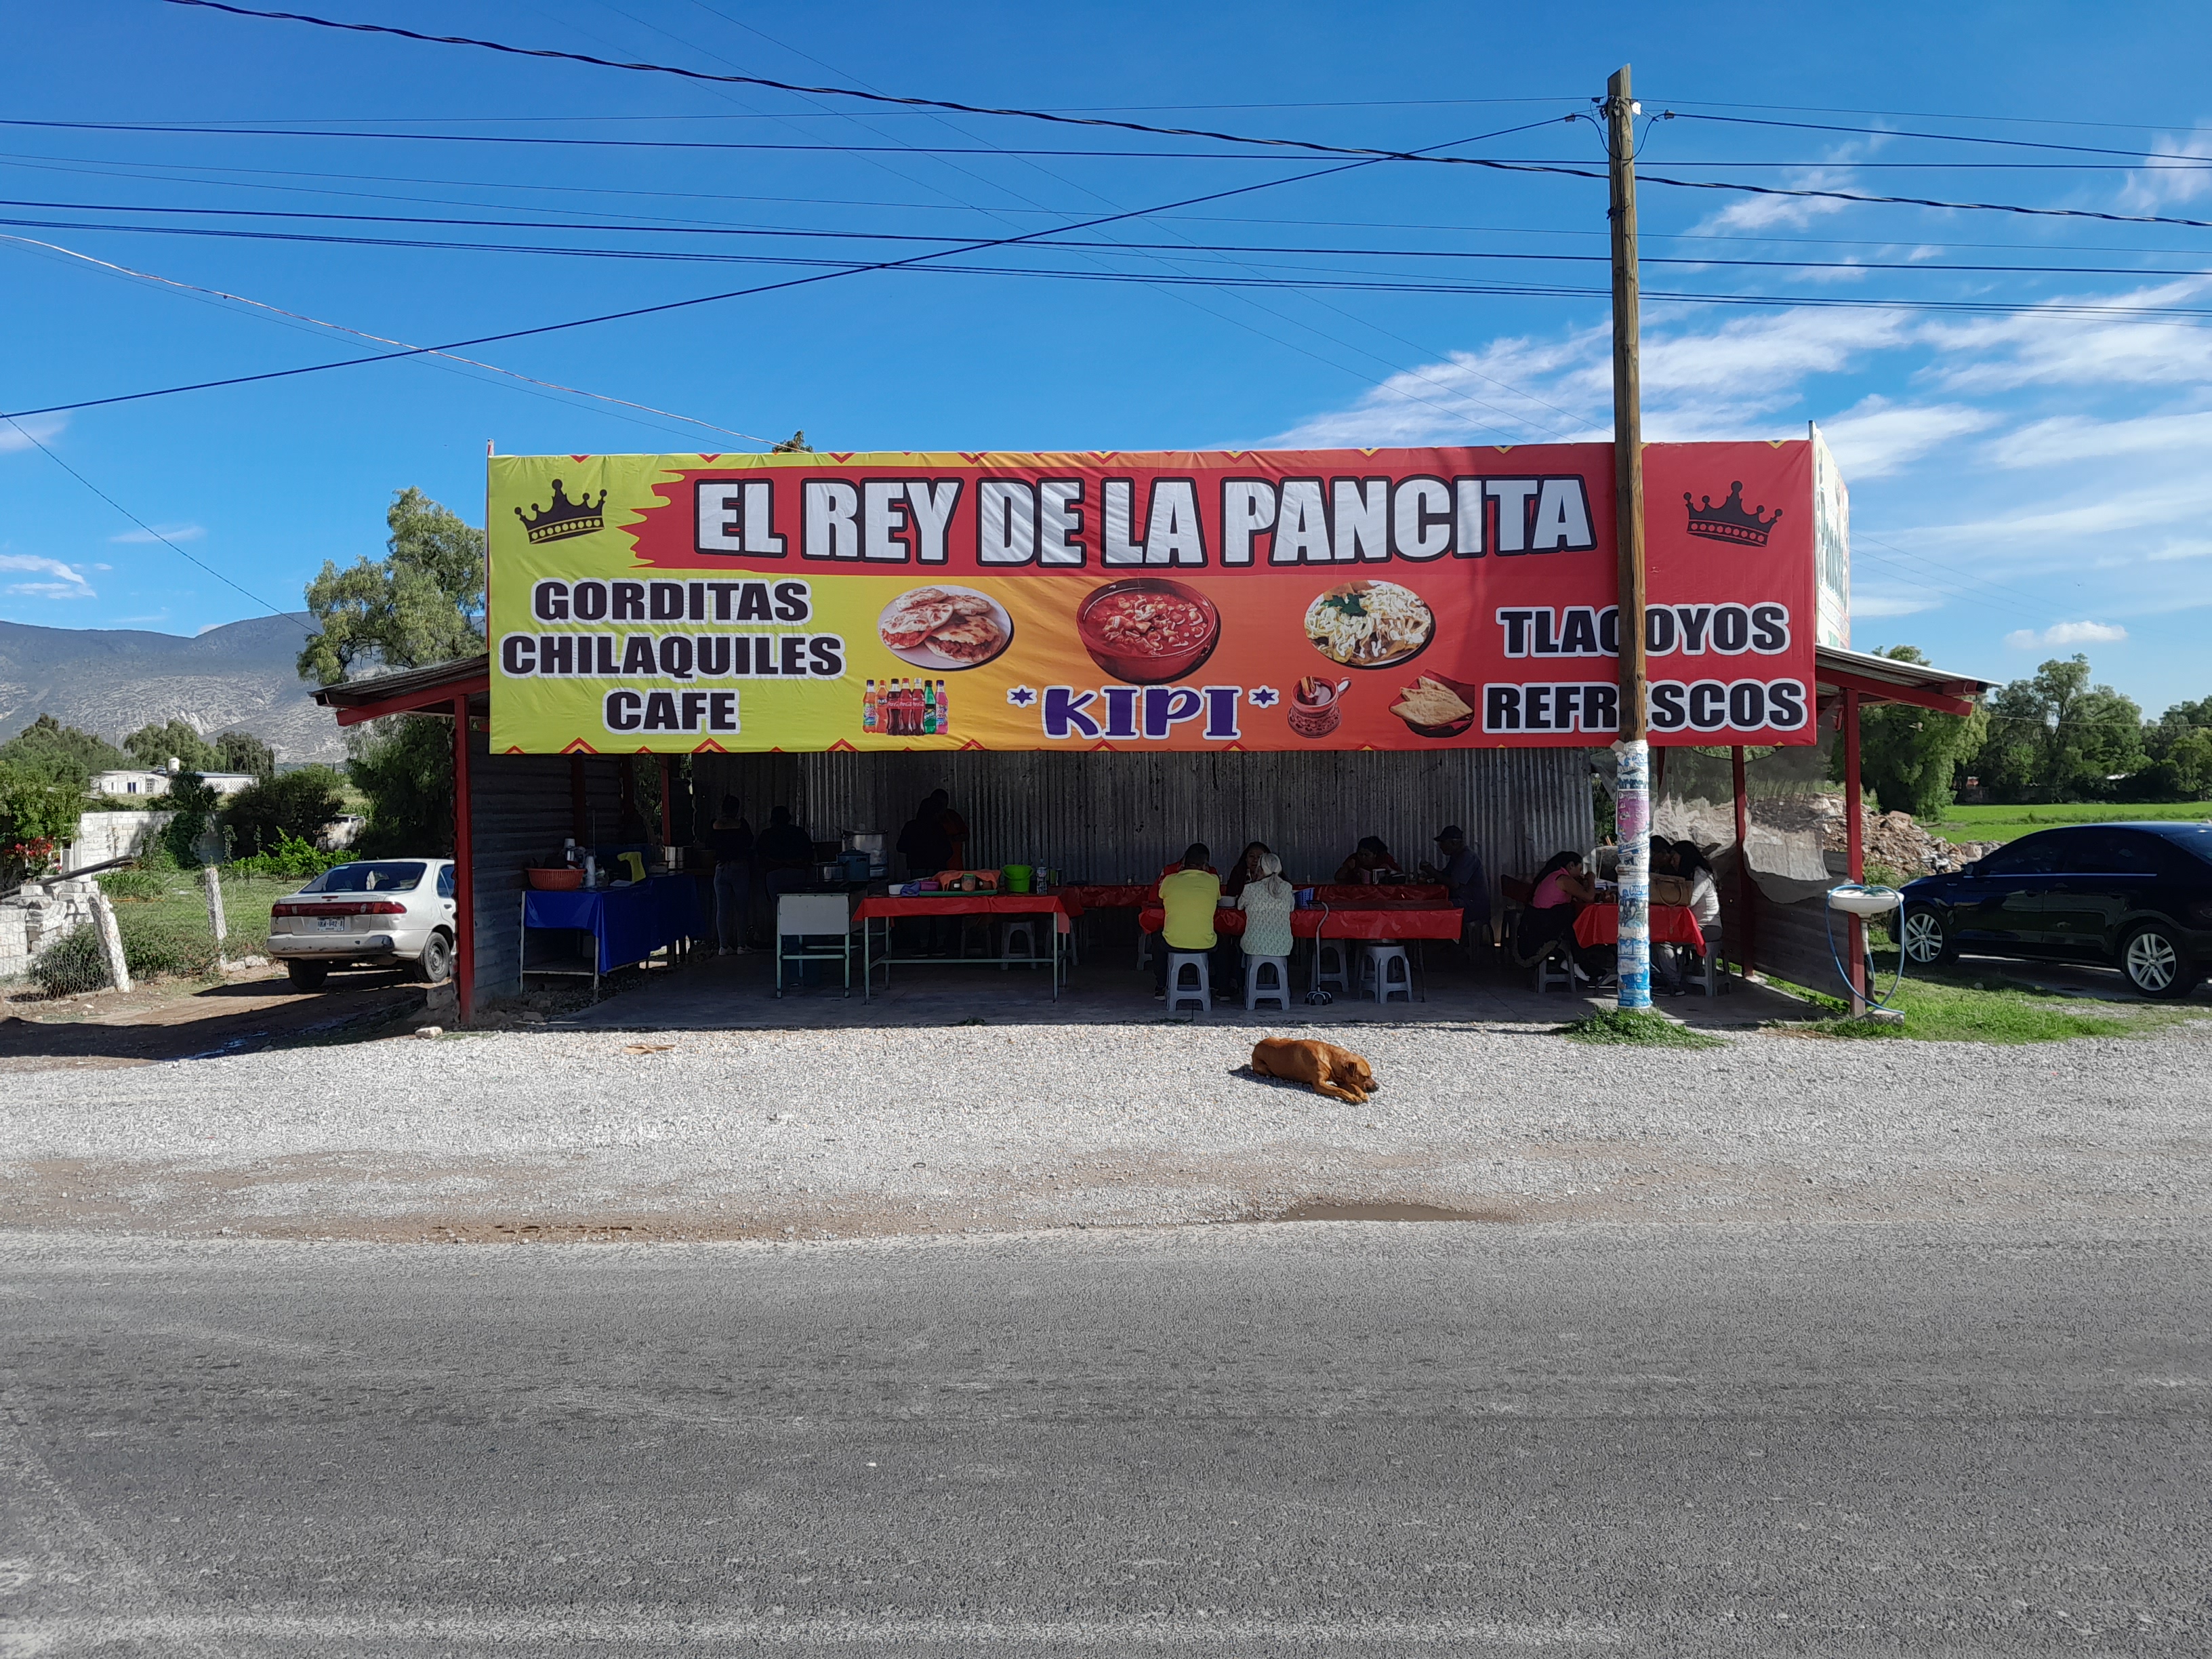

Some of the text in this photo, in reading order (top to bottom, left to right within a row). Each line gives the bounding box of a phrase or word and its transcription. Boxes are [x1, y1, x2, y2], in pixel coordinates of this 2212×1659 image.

[695, 474, 1597, 567] EL REY DE LA PANCITA
[534, 580, 808, 621] GORDITAS
[501, 634, 843, 678] CHILAQUILES
[606, 690, 737, 731] CAFE
[1487, 682, 1803, 731] REFRSCOS
